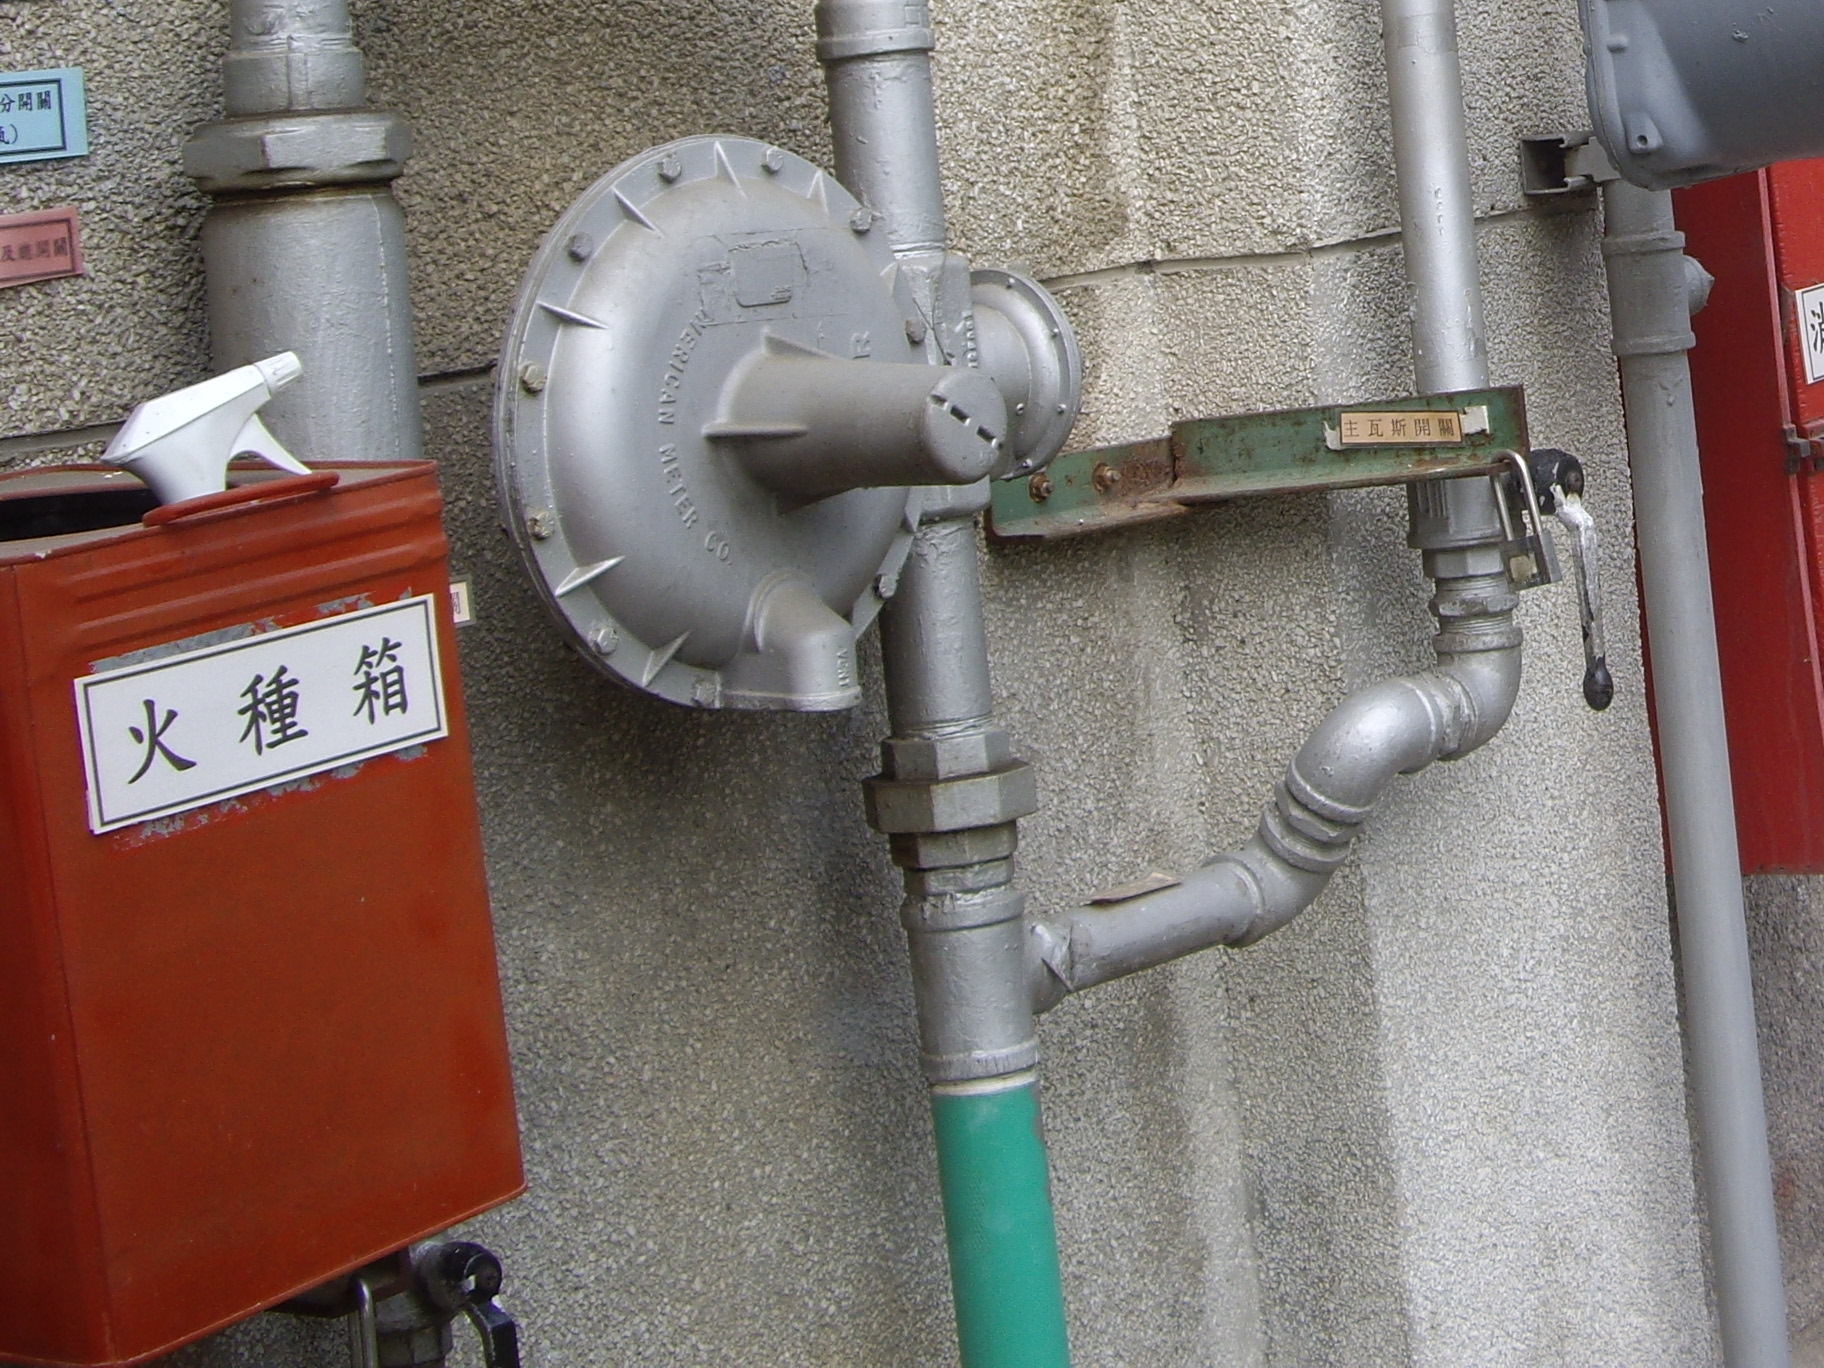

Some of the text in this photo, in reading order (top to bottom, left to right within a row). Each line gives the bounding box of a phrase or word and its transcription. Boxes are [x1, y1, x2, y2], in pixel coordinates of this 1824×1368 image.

[1343, 417, 1455, 438] 主瓦斯開關
[659, 442, 699, 530] METER
[126, 635, 410, 785] 火種箱
